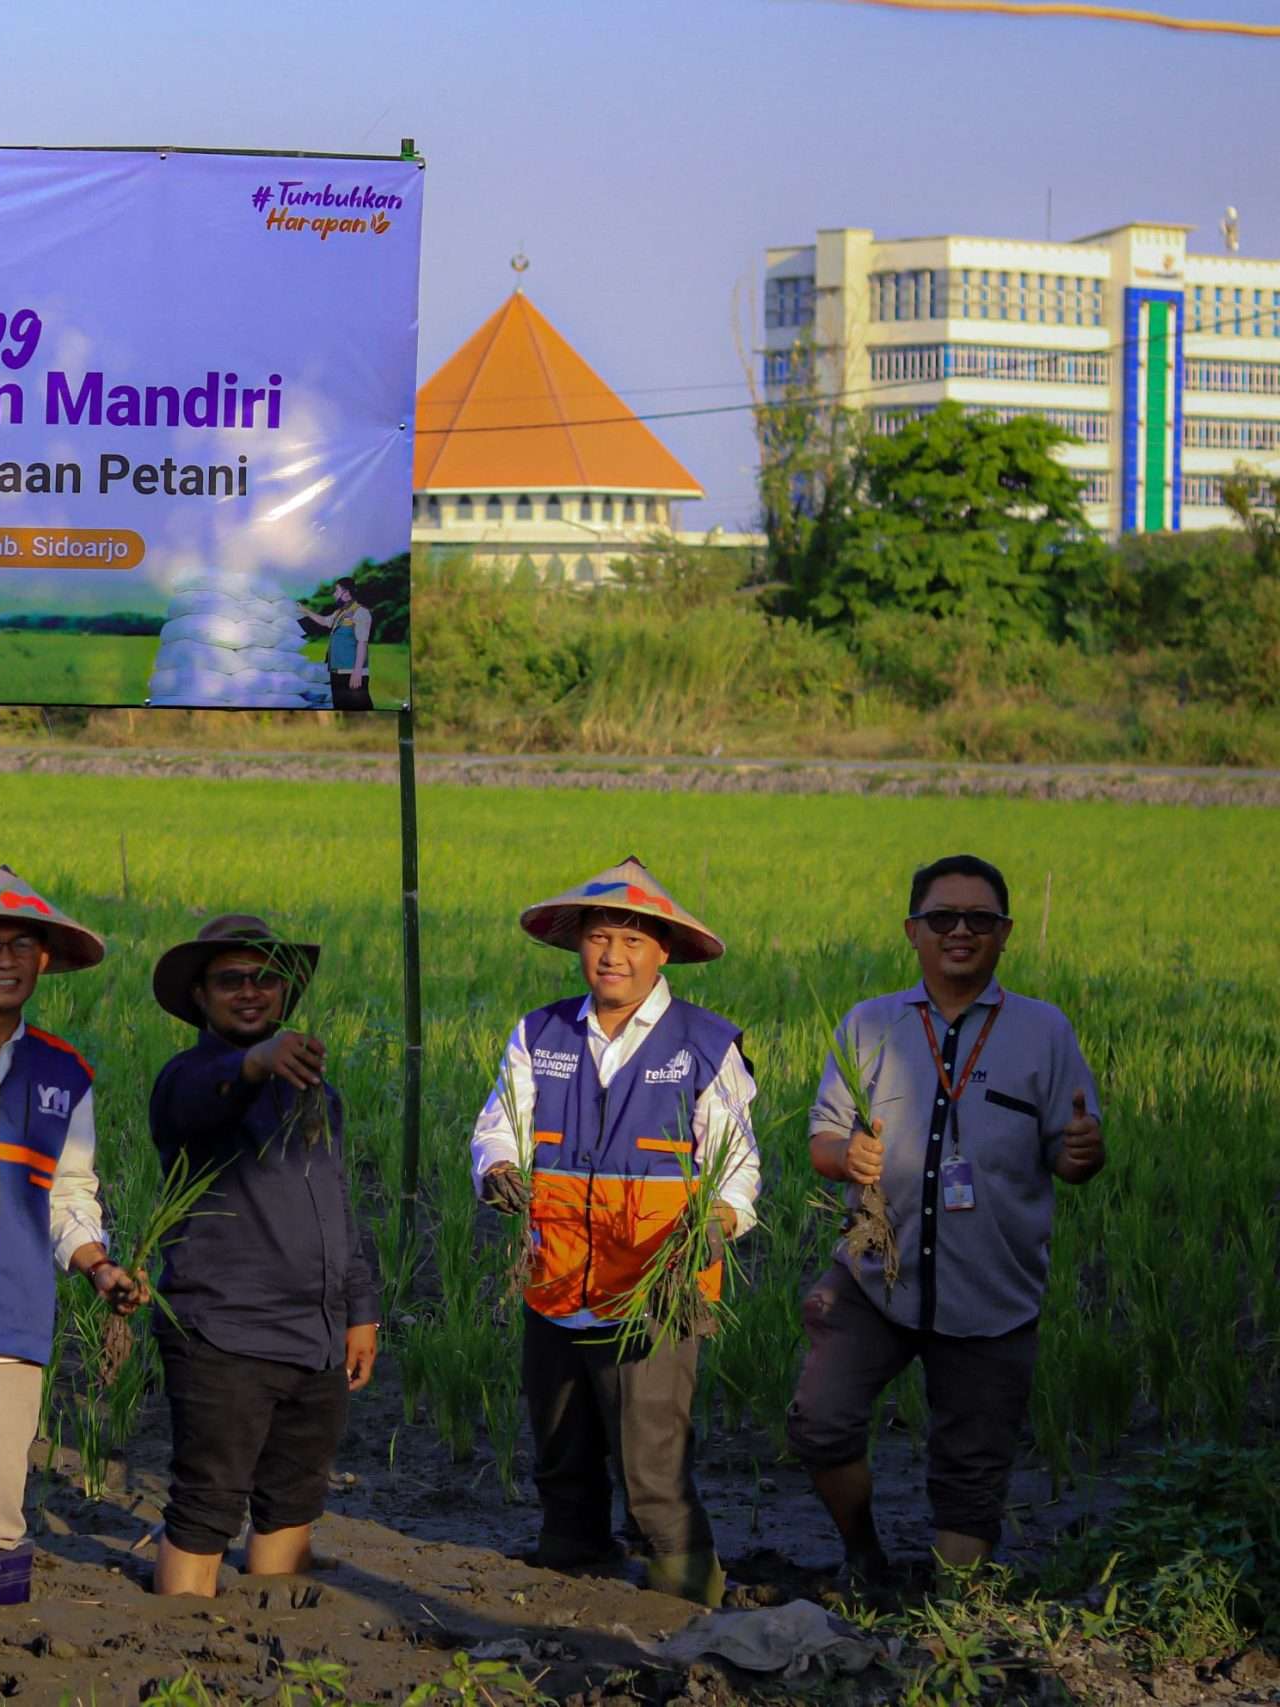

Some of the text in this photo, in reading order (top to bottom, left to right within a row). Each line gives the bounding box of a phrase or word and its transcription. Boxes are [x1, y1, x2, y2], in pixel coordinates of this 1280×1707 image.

[251, 181, 403, 213] #Tumbuhkan
[266, 206, 367, 240] Harapan
[45, 371, 282, 429] Mandiri
[99, 454, 247, 496] Petani
[32, 536, 129, 562] Sidoarjo
